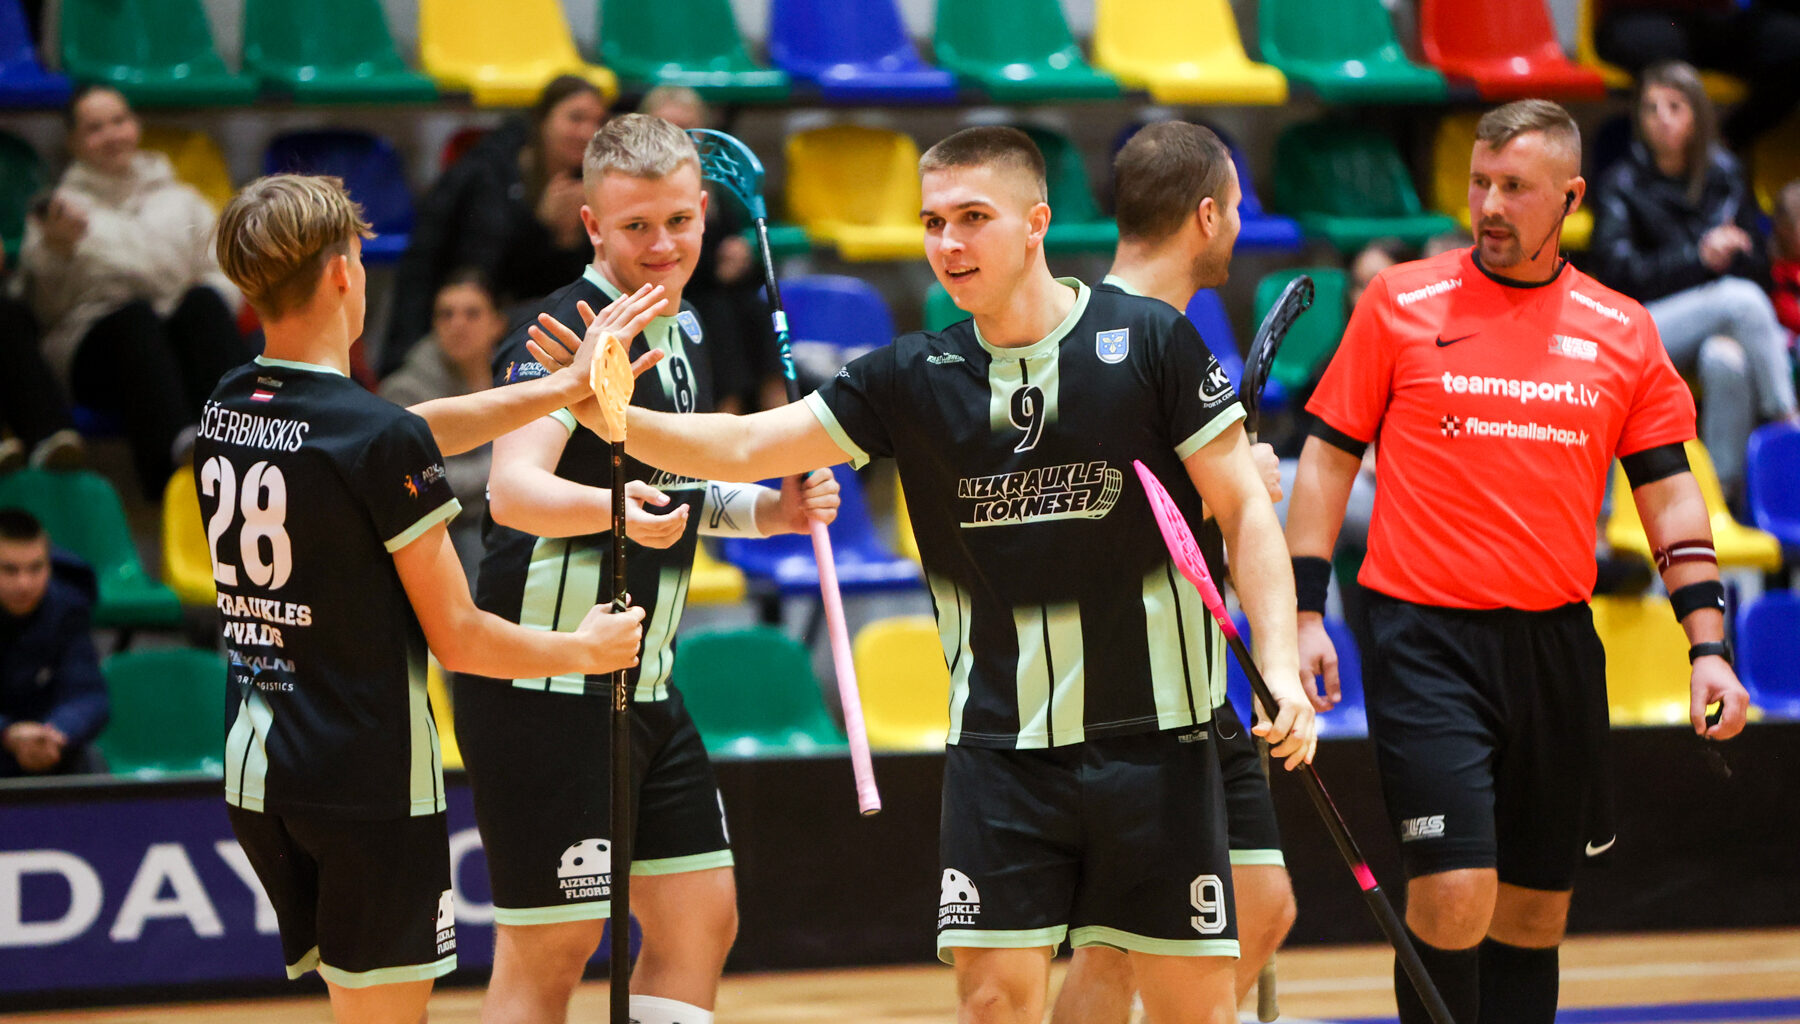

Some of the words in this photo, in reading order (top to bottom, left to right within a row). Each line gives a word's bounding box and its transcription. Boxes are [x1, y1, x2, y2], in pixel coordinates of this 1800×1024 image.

[1397, 278, 1462, 306] floorball.lv
[1570, 290, 1630, 325] floorball.lv
[668, 353, 696, 414] 8
[1441, 371, 1599, 407] teamsport.lv
[1008, 384, 1046, 453] 9
[1465, 417, 1589, 447] floorballshop.lv
[958, 461, 1107, 500] AIZKRAUKLE
[201, 455, 292, 590] 28
[974, 489, 1091, 523] KOKNESE
[1190, 874, 1227, 934] 9
